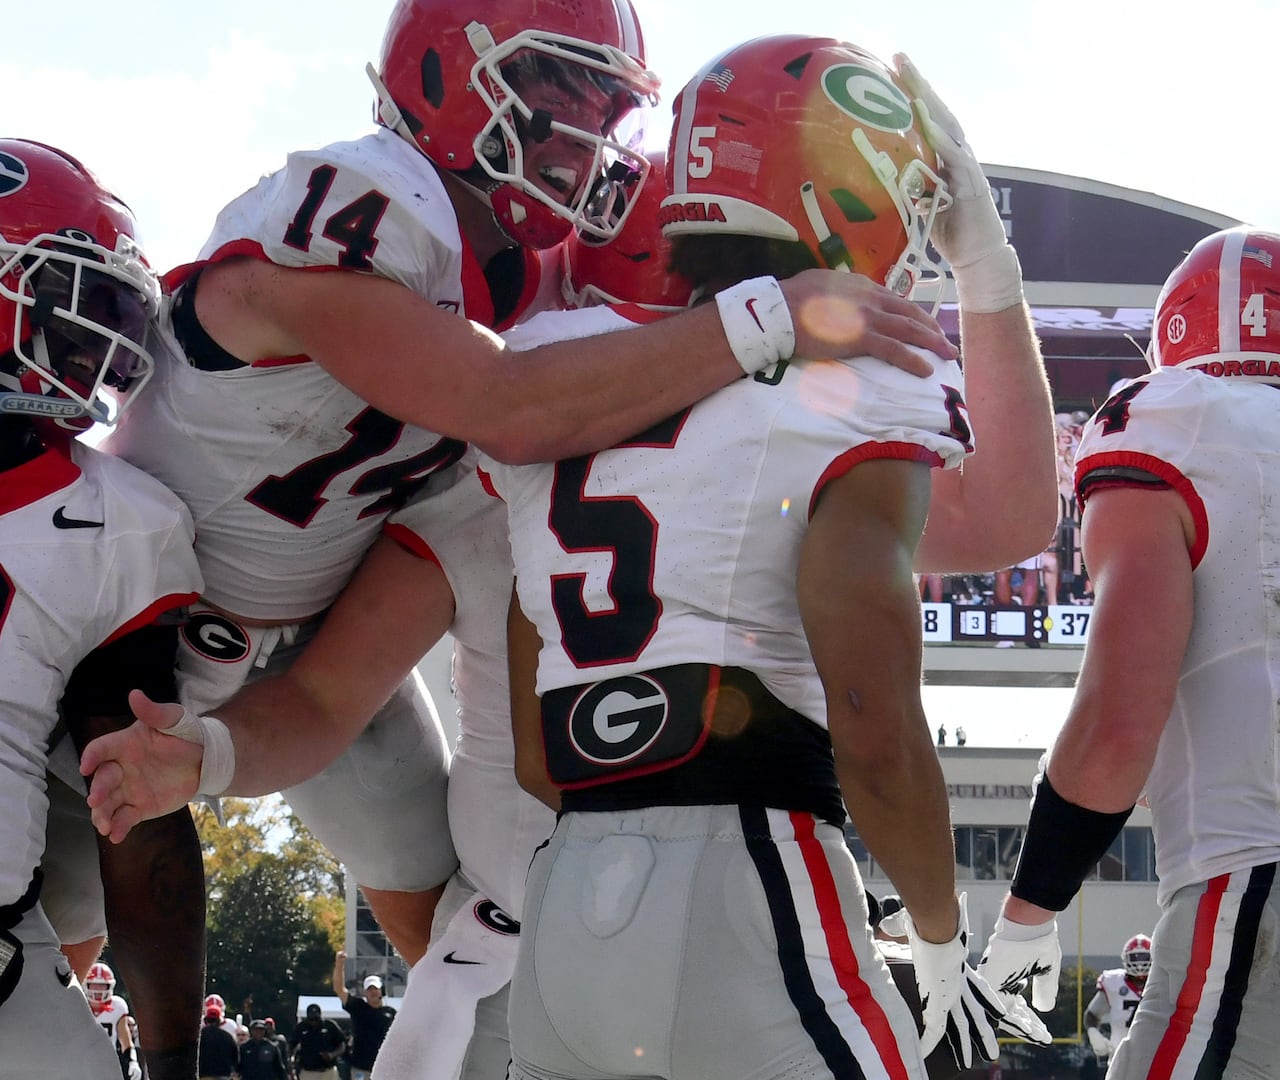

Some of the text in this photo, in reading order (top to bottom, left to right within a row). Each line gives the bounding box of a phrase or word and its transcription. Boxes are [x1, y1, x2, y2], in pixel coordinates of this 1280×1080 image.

[833, 69, 912, 124] G
[688, 126, 717, 179] 5
[283, 163, 390, 272] 14
[658, 202, 728, 228] ORGIA
[1167, 316, 1186, 342] SEC
[1241, 293, 1267, 337] 4
[6, 398, 78, 416] BATTLE
[1094, 381, 1149, 437] 4
[549, 407, 690, 668] 5
[188, 617, 250, 656] G
[971, 616, 980, 630] 3
[1061, 612, 1090, 636] 37
[582, 681, 667, 755] G
